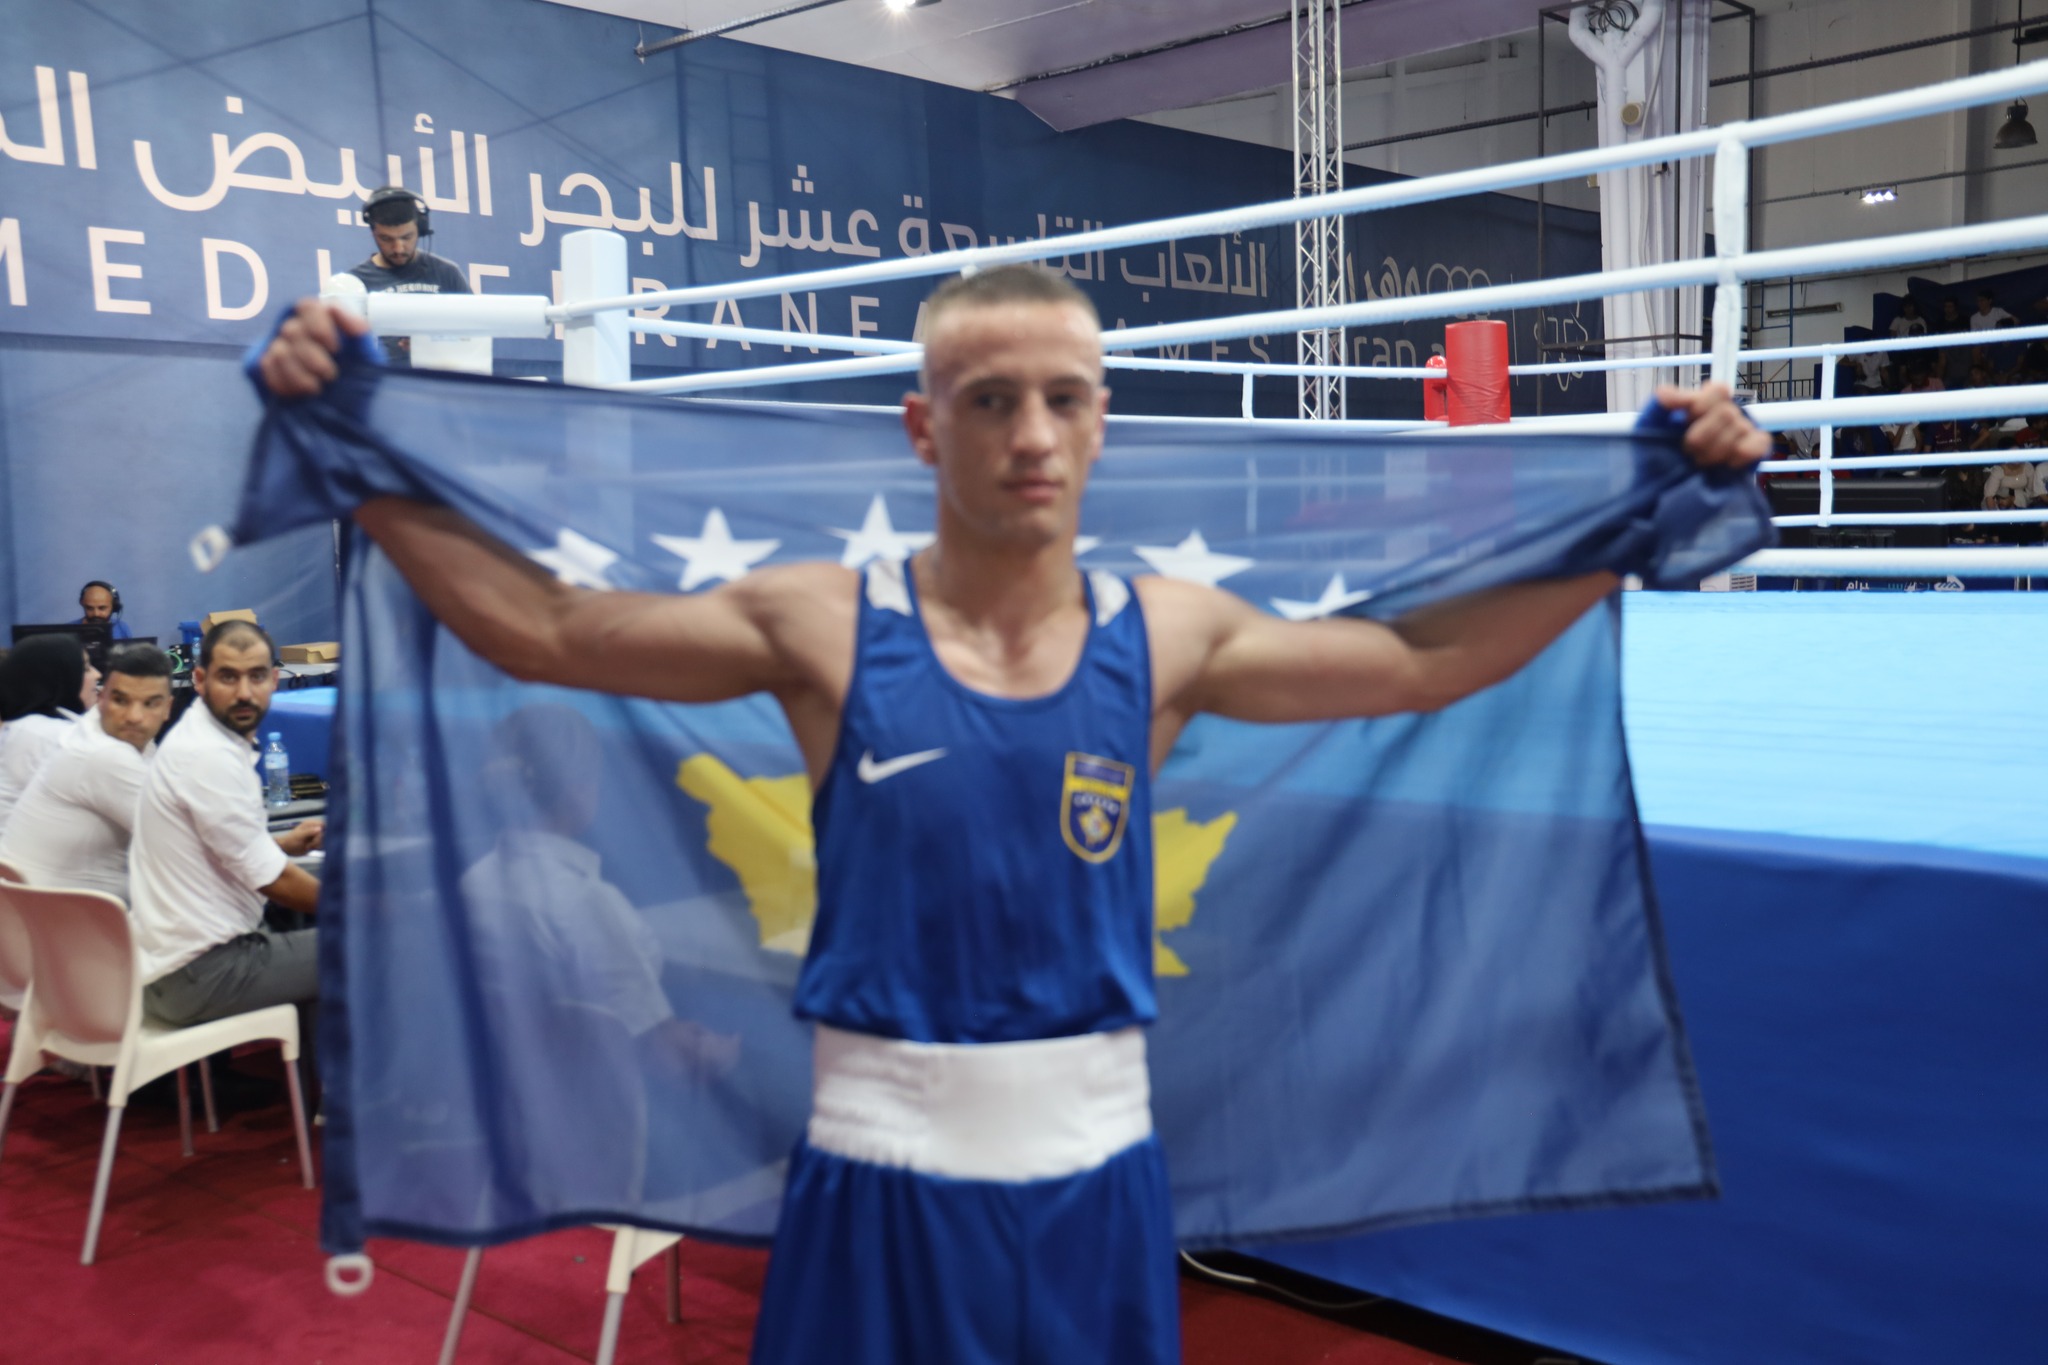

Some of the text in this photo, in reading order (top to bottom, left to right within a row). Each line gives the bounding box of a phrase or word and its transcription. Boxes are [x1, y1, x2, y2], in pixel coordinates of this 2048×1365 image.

[520, 162, 719, 256] للبحر
[740, 165, 882, 268] عشر
[1105, 317, 1272, 378] AMES
